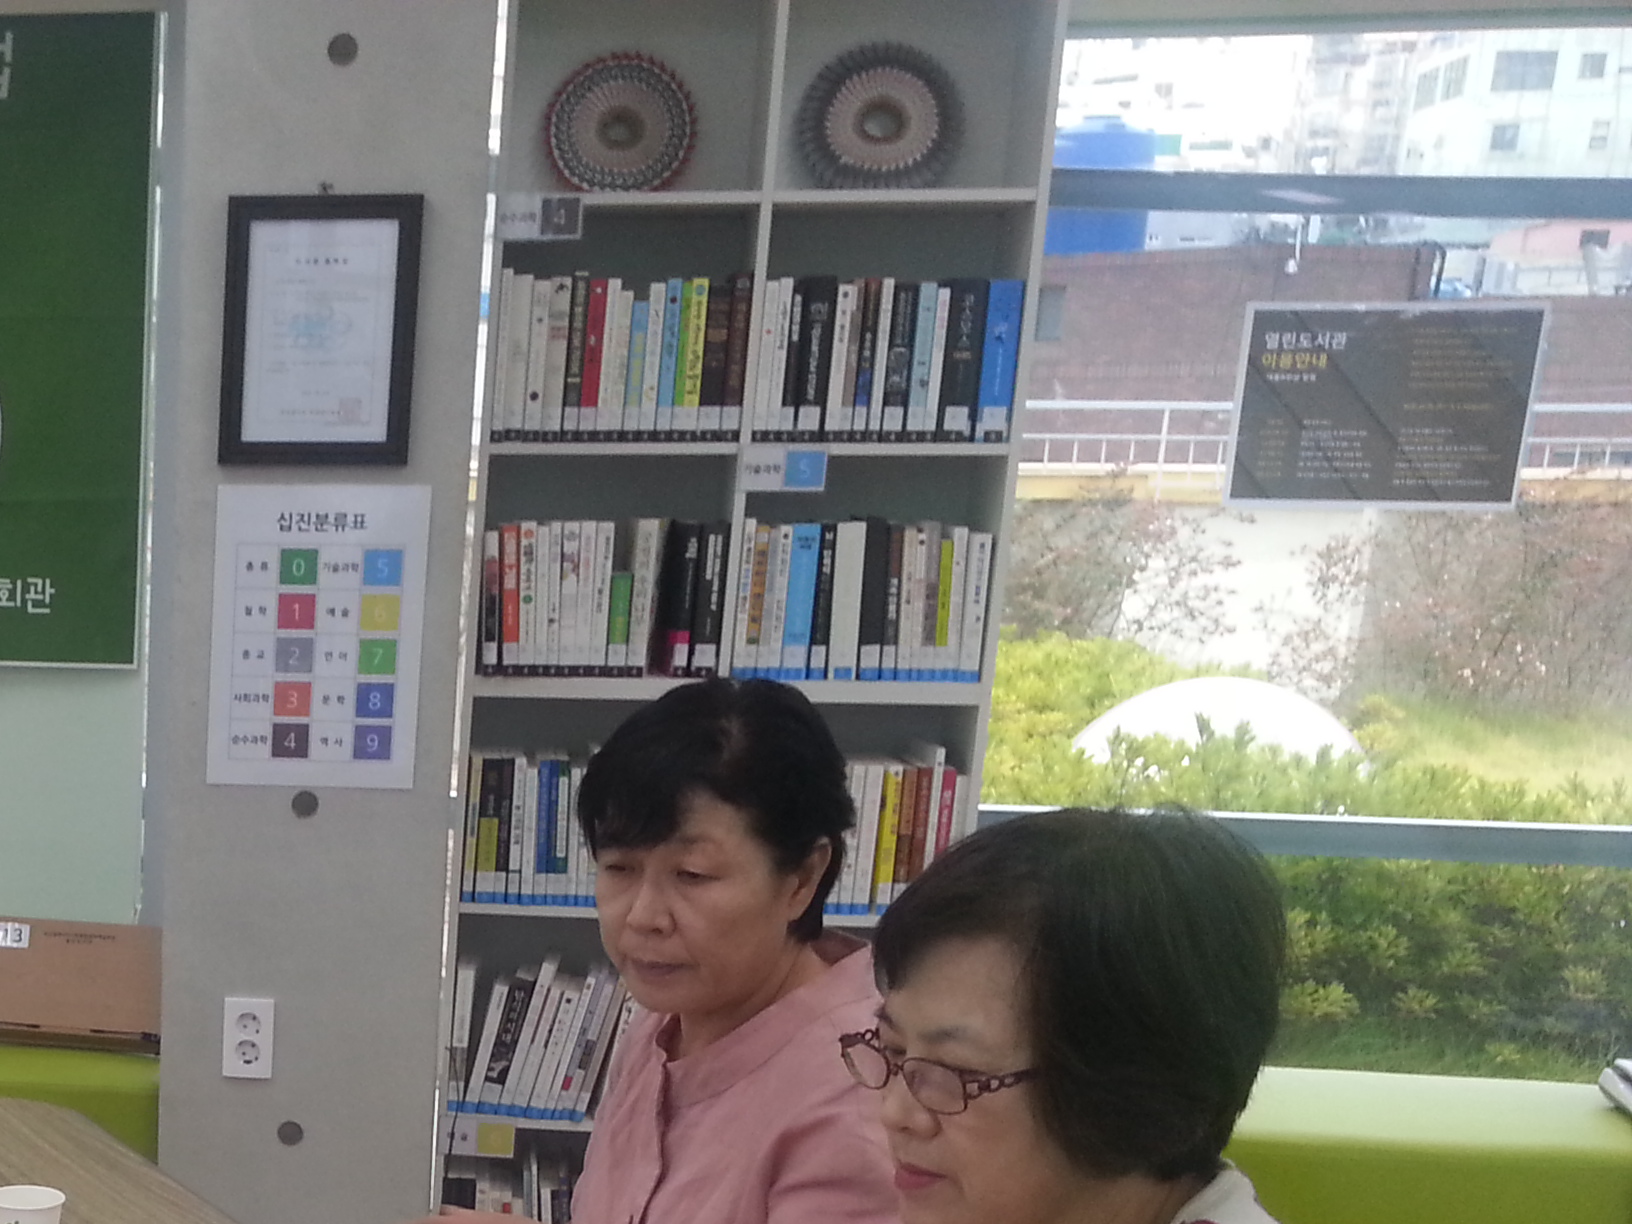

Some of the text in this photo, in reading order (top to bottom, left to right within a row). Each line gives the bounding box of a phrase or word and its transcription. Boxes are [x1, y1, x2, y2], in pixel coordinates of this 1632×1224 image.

[1265, 331, 1347, 350] 열린도서관
[1262, 352, 1328, 369] 이용안내
[277, 512, 368, 532] 십진분류표
[292, 558, 304, 577] 0
[322, 562, 359, 572] 기술과학
[377, 559, 388, 577] 5
[291, 603, 300, 621] 1
[374, 604, 386, 623] 6
[289, 647, 299, 665] 2
[371, 648, 383, 666] 7
[233, 693, 269, 704] 사회과학
[286, 690, 298, 709] 3
[369, 692, 381, 710] 8
[231, 735, 268, 746] 순수과학
[284, 732, 296, 750] 4
[366, 734, 379, 752] 9
[0, 923, 23, 945] 13
